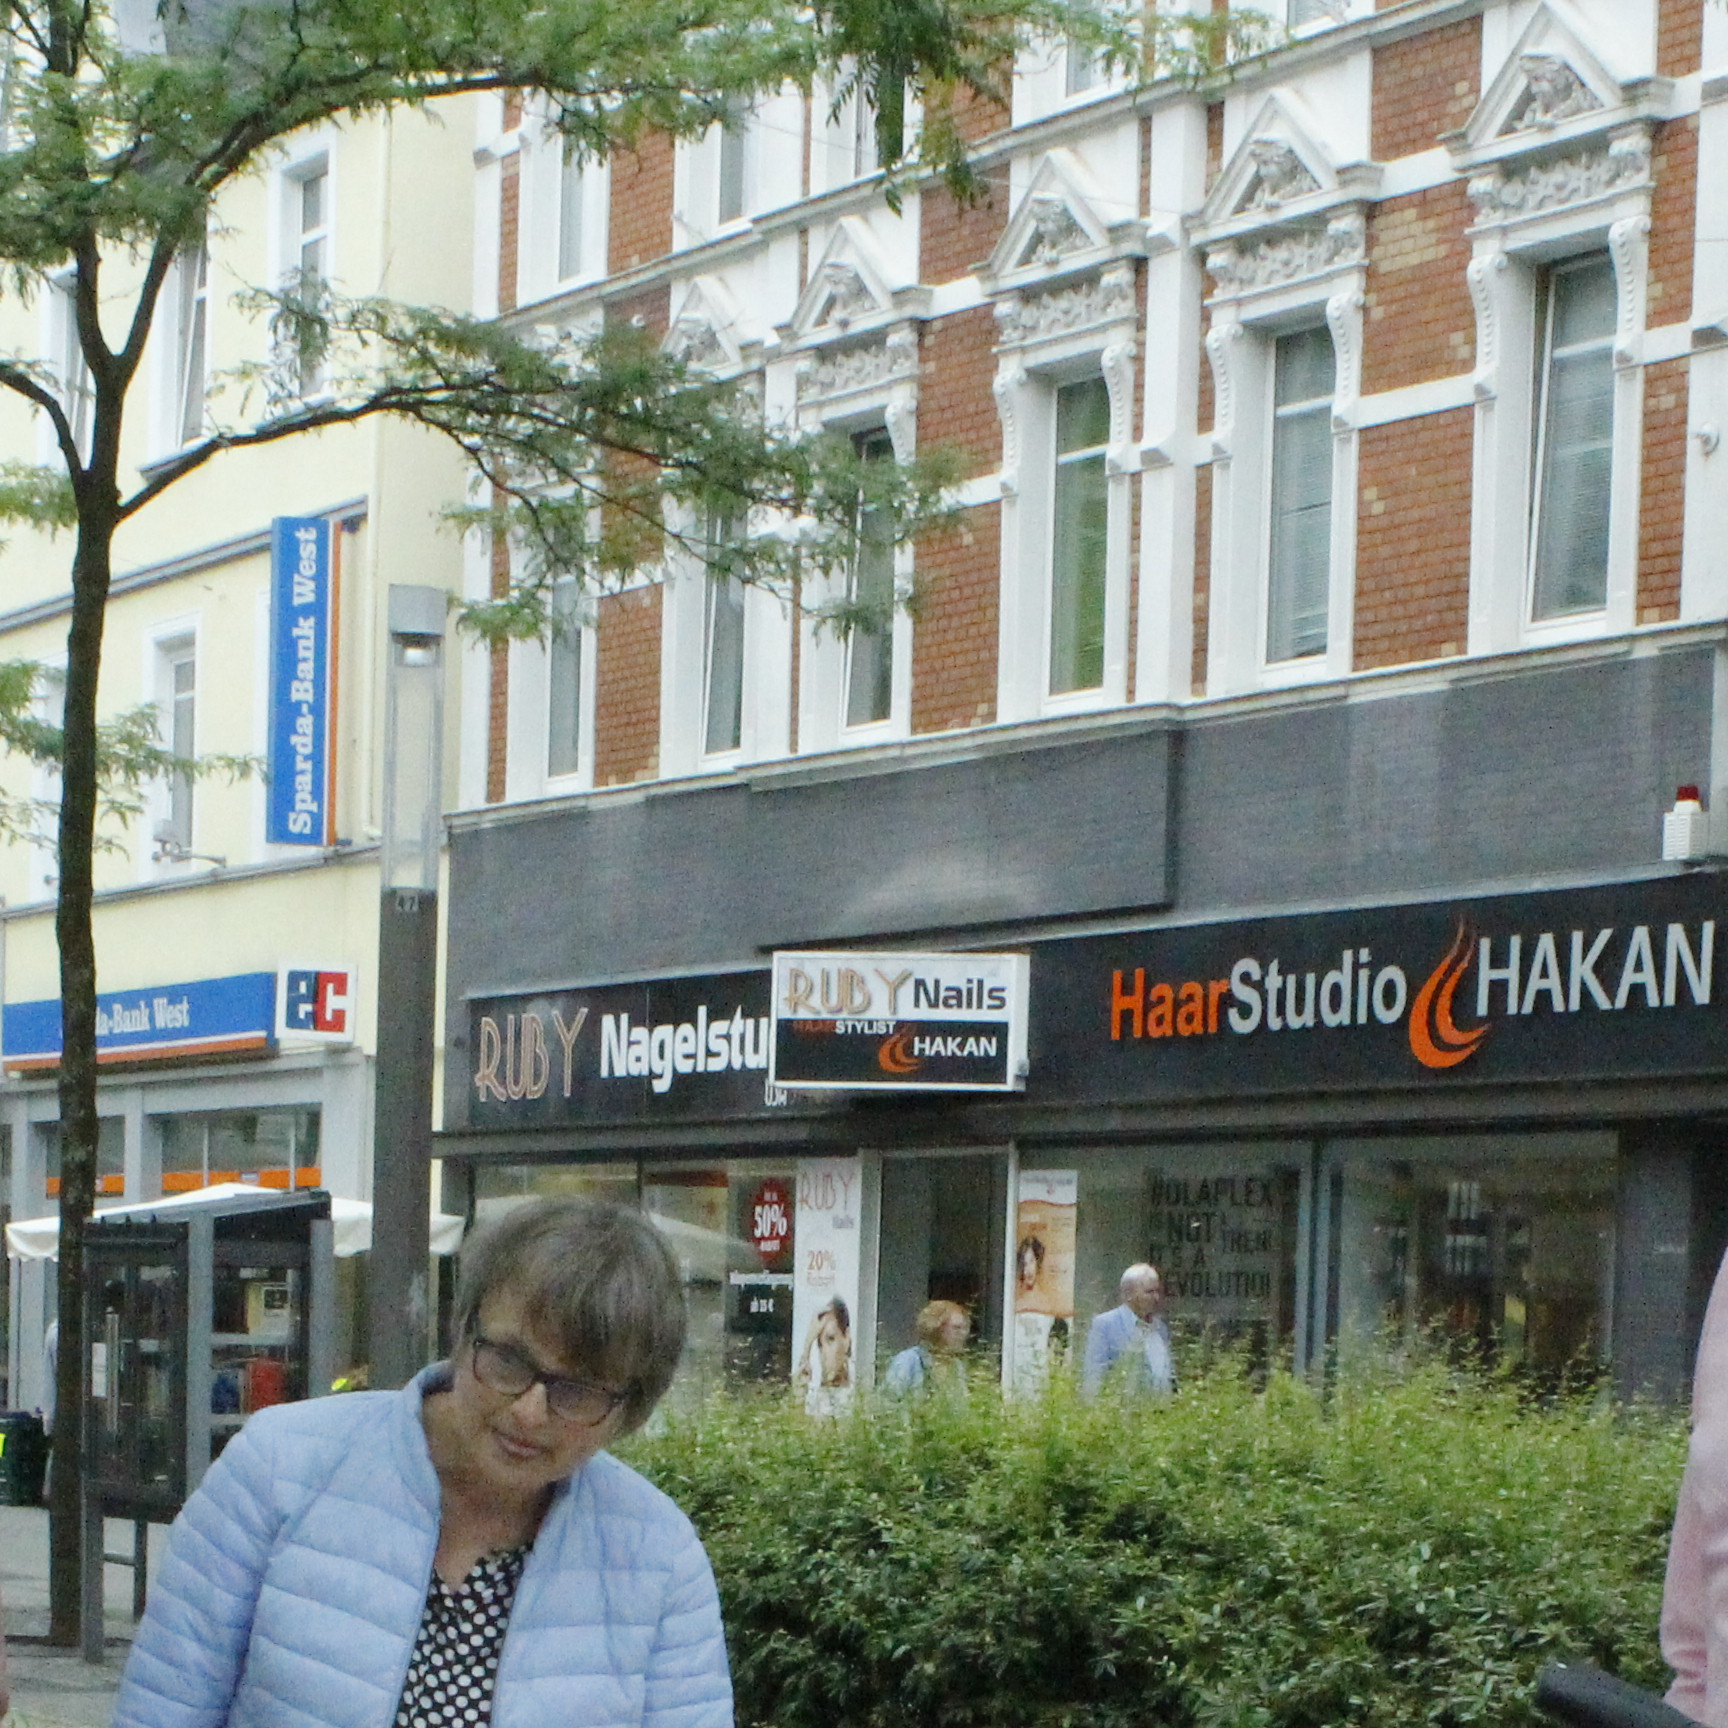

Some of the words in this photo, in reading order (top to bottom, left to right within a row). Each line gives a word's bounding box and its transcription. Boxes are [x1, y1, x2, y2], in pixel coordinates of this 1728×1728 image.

[292, 526, 318, 607] West
[287, 616, 316, 836] Sparda-Bank
[783, 966, 913, 1017] RUBY
[913, 977, 1008, 1011] Nails
[1110, 945, 1408, 1043] HaarStudio
[1477, 918, 1717, 1018] HAKAN
[95, 999, 150, 1036] a-Bank
[153, 996, 190, 1030] West
[475, 1006, 589, 1104] RUBY
[599, 1003, 770, 1094] Nagelstu
[913, 1035, 998, 1058] HAKAN
[798, 1171, 856, 1212] RUBY
[753, 1204, 789, 1239] 50%
[1162, 1270, 1272, 1299] EVOLUTION
